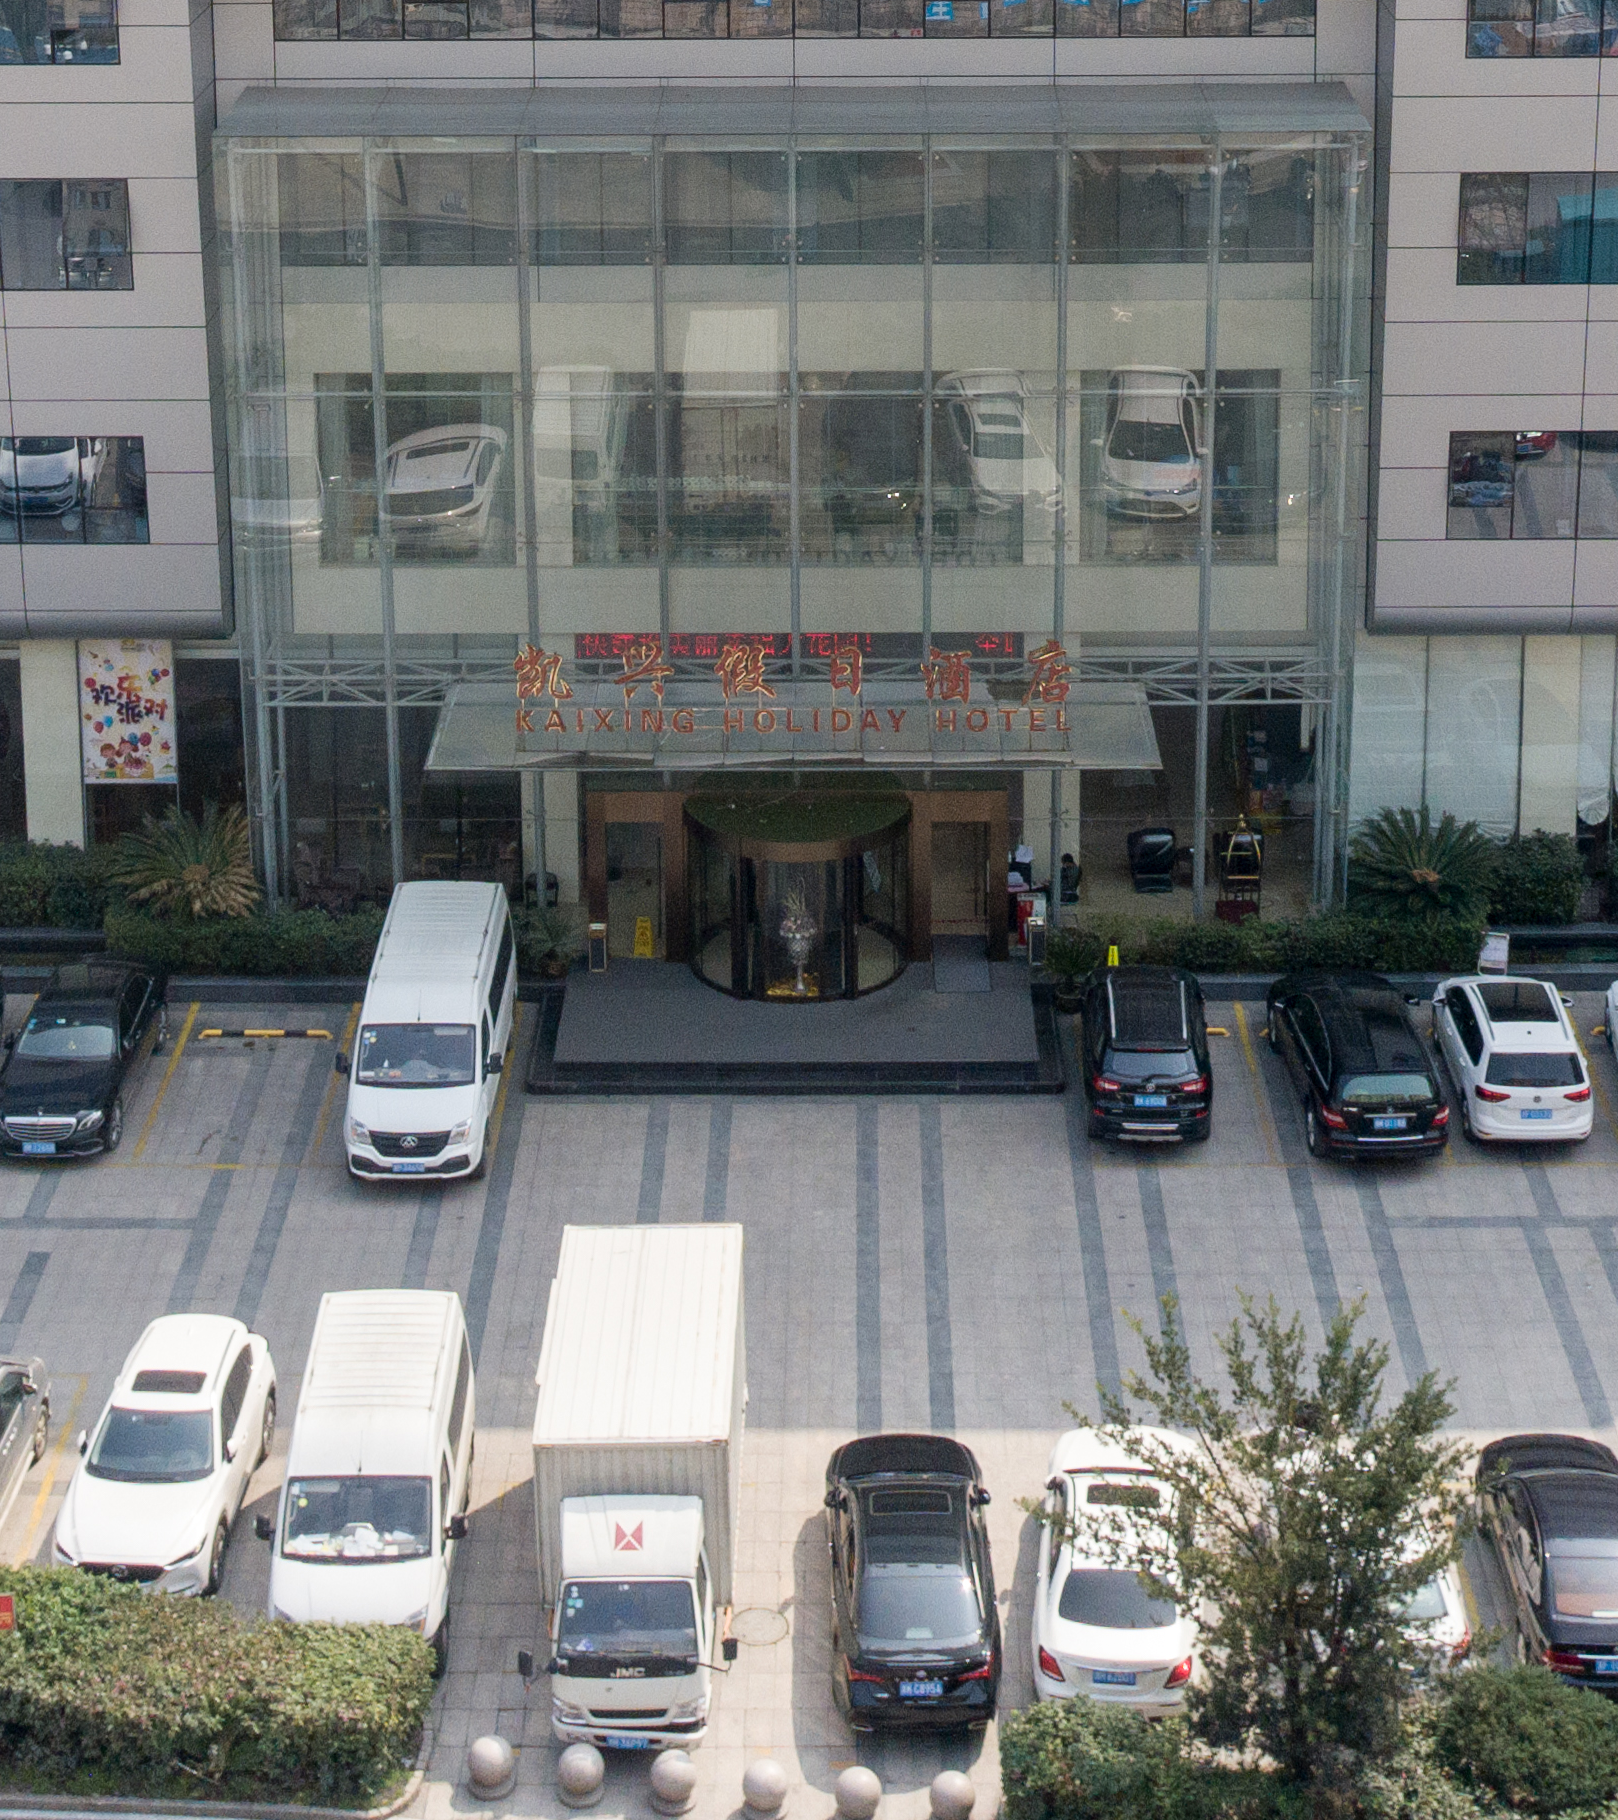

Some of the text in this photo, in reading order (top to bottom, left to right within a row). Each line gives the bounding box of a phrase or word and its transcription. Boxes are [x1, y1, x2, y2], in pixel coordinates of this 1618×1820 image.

[512, 638, 1073, 706] 凯兴假日酒店
[514, 708, 1073, 734] KAIXING HOLIDAY HOTEL
